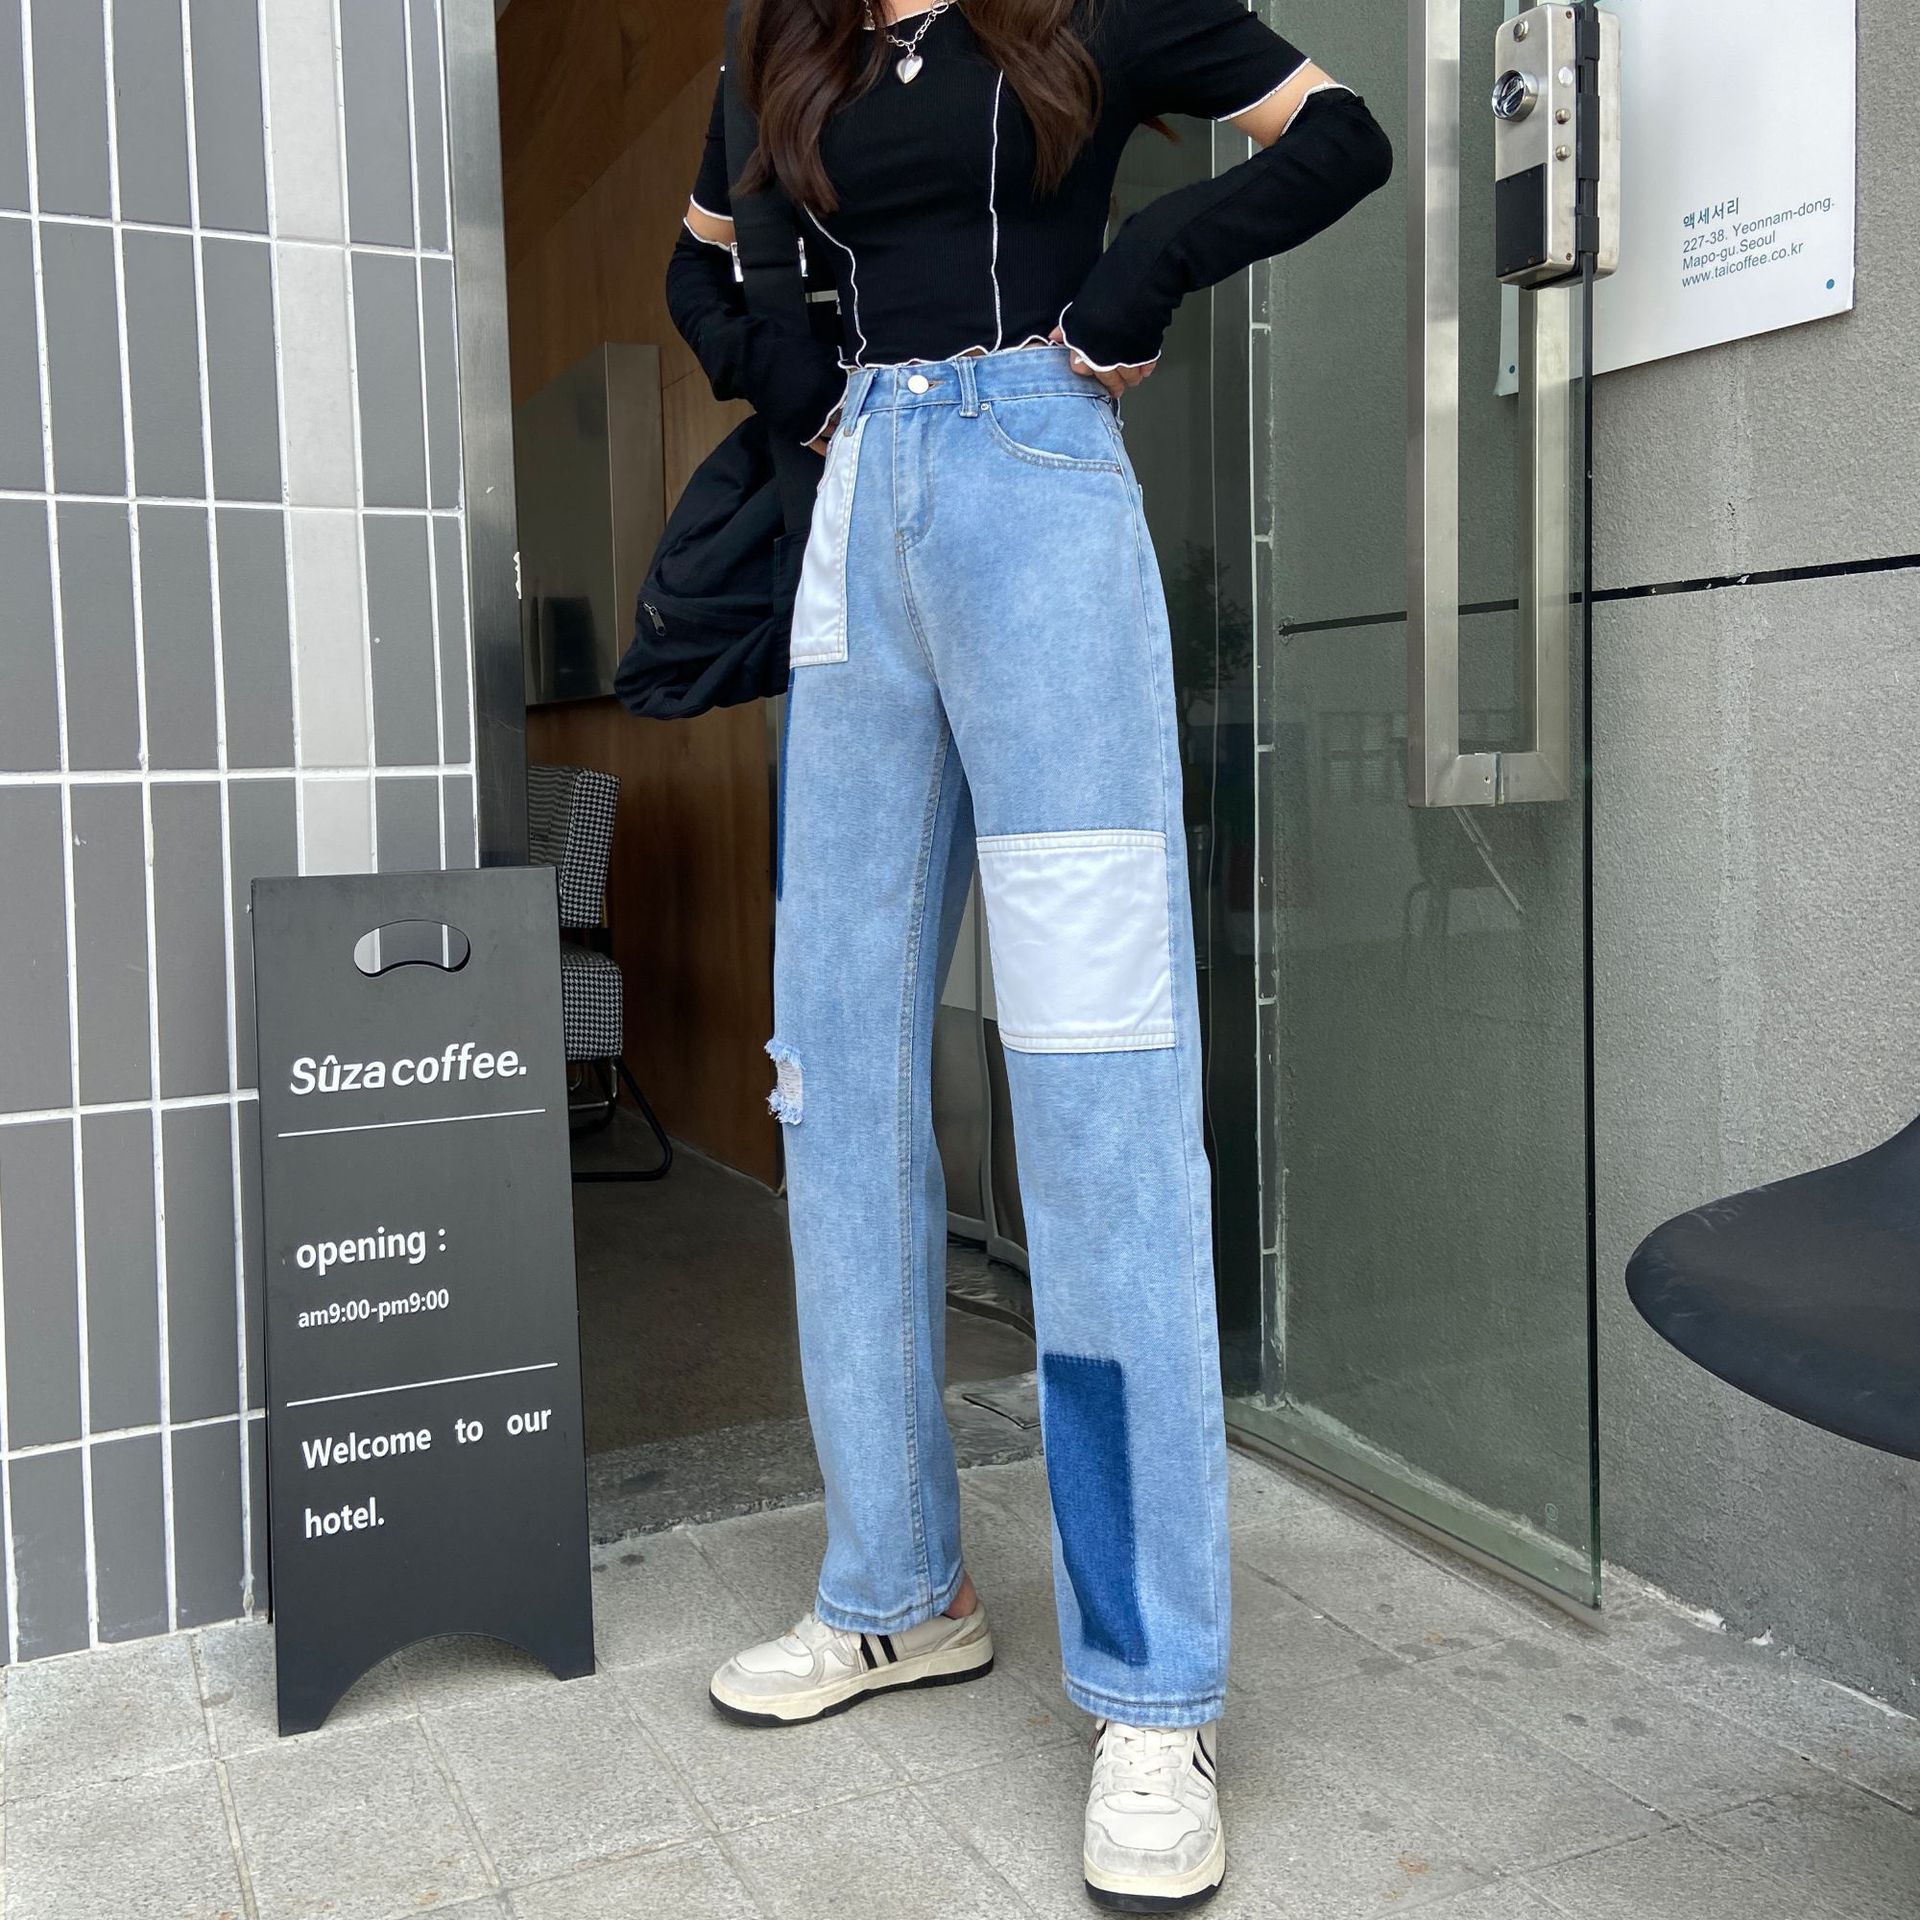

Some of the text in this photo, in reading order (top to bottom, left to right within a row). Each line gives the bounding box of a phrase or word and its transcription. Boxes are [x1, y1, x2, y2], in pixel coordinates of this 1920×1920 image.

[1683, 197, 1739, 229] 액세서리
[1682, 242, 1804, 288] www.taicoffee.co.kr
[290, 1042, 527, 1095] Sûza coffee.
[296, 1226, 426, 1276] opening
[298, 1288, 450, 1328] am9:00-pm9:00
[302, 1408, 552, 1470] Welcome to our
[304, 1496, 385, 1539] hotel.
